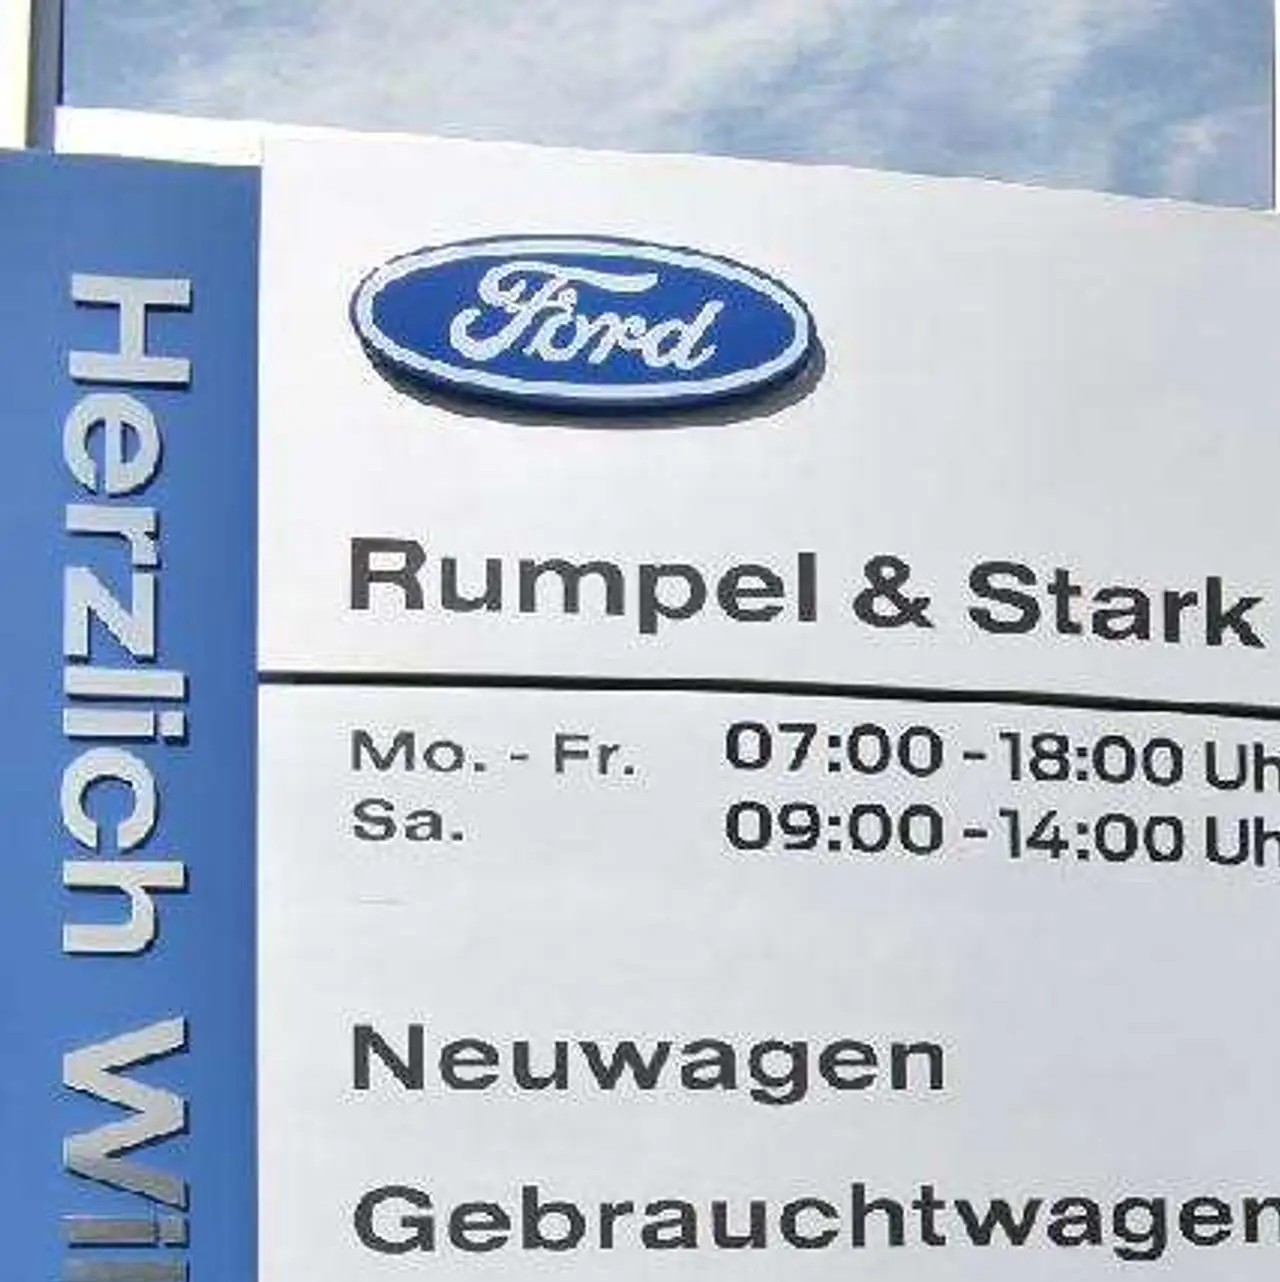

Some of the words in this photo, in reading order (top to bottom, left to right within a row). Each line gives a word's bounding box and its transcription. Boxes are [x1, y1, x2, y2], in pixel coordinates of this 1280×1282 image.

[449, 260, 725, 371] Ford
[61, 272, 192, 955] Herzlich
[349, 536, 818, 636] Rumpel
[851, 554, 936, 630] &
[967, 560, 1266, 650] Stark
[351, 728, 486, 774] Mo.
[554, 732, 635, 776] Fr.
[724, 720, 945, 779] 07:00
[352, 797, 464, 842] Sa.
[724, 799, 945, 857] 09:00
[352, 1023, 945, 1107] Neuwagen
